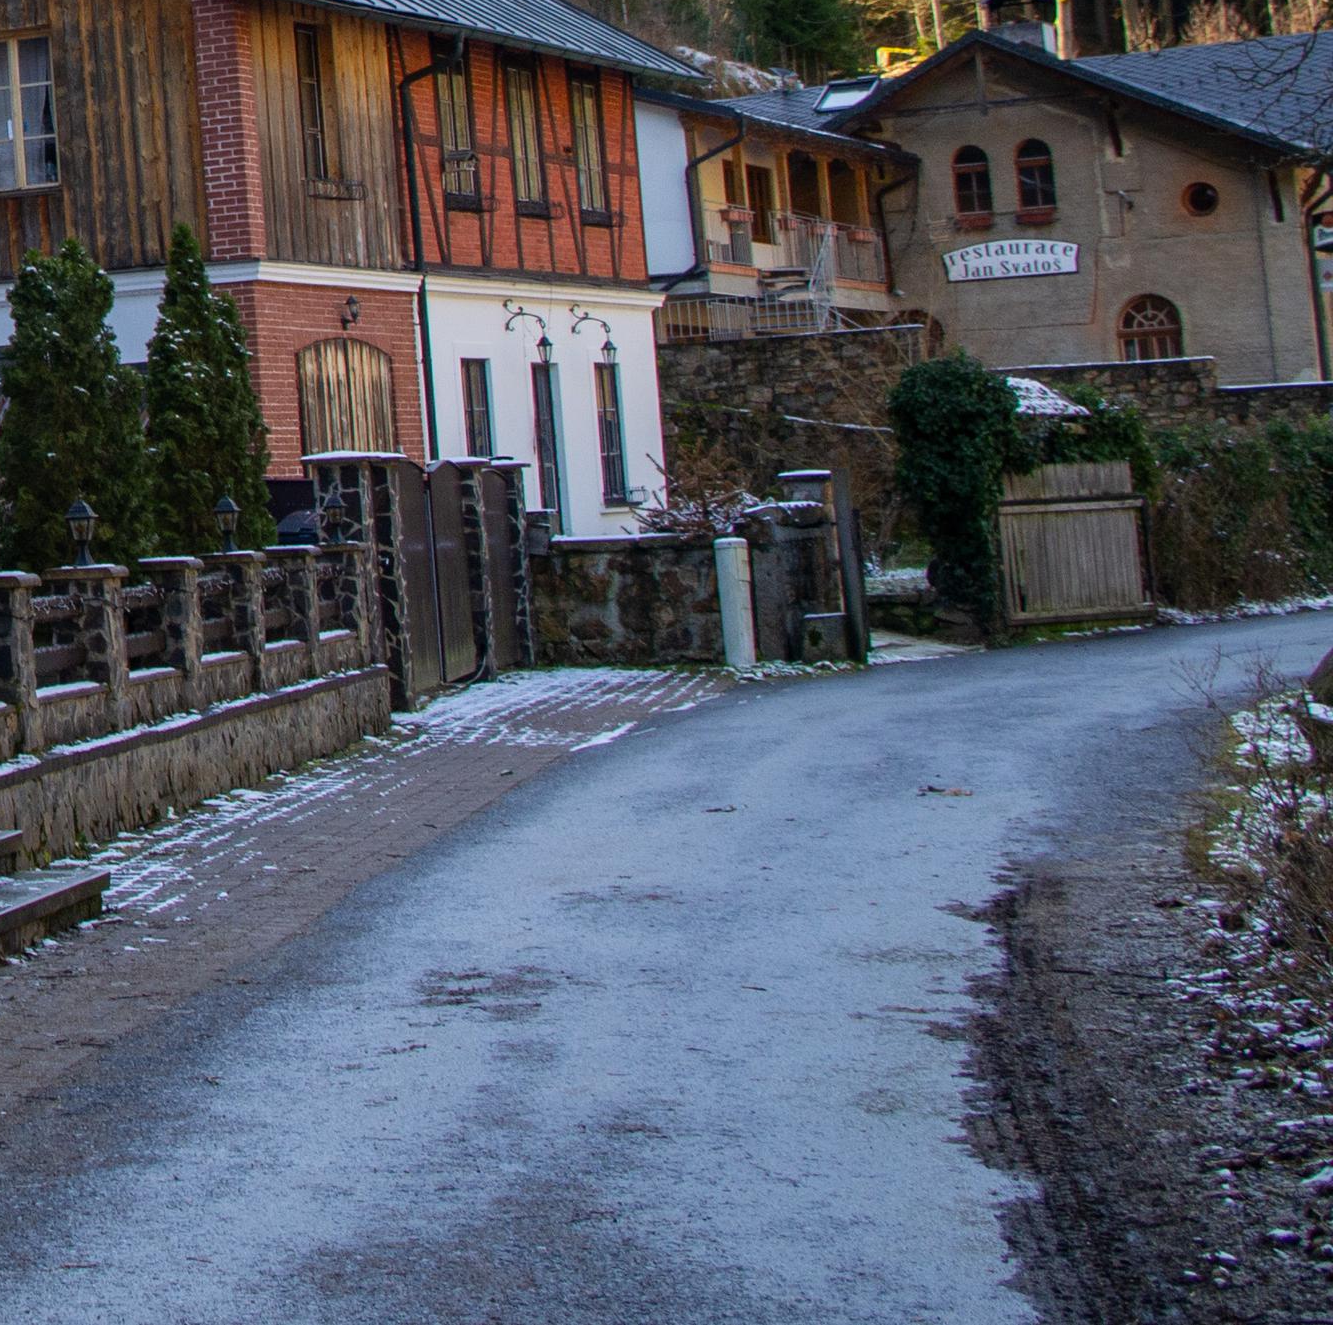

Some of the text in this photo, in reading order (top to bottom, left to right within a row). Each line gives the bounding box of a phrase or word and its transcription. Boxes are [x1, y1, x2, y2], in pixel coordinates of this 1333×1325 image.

[948, 242, 1074, 266] restaurace
[960, 258, 1062, 279] Jan Svatoš
